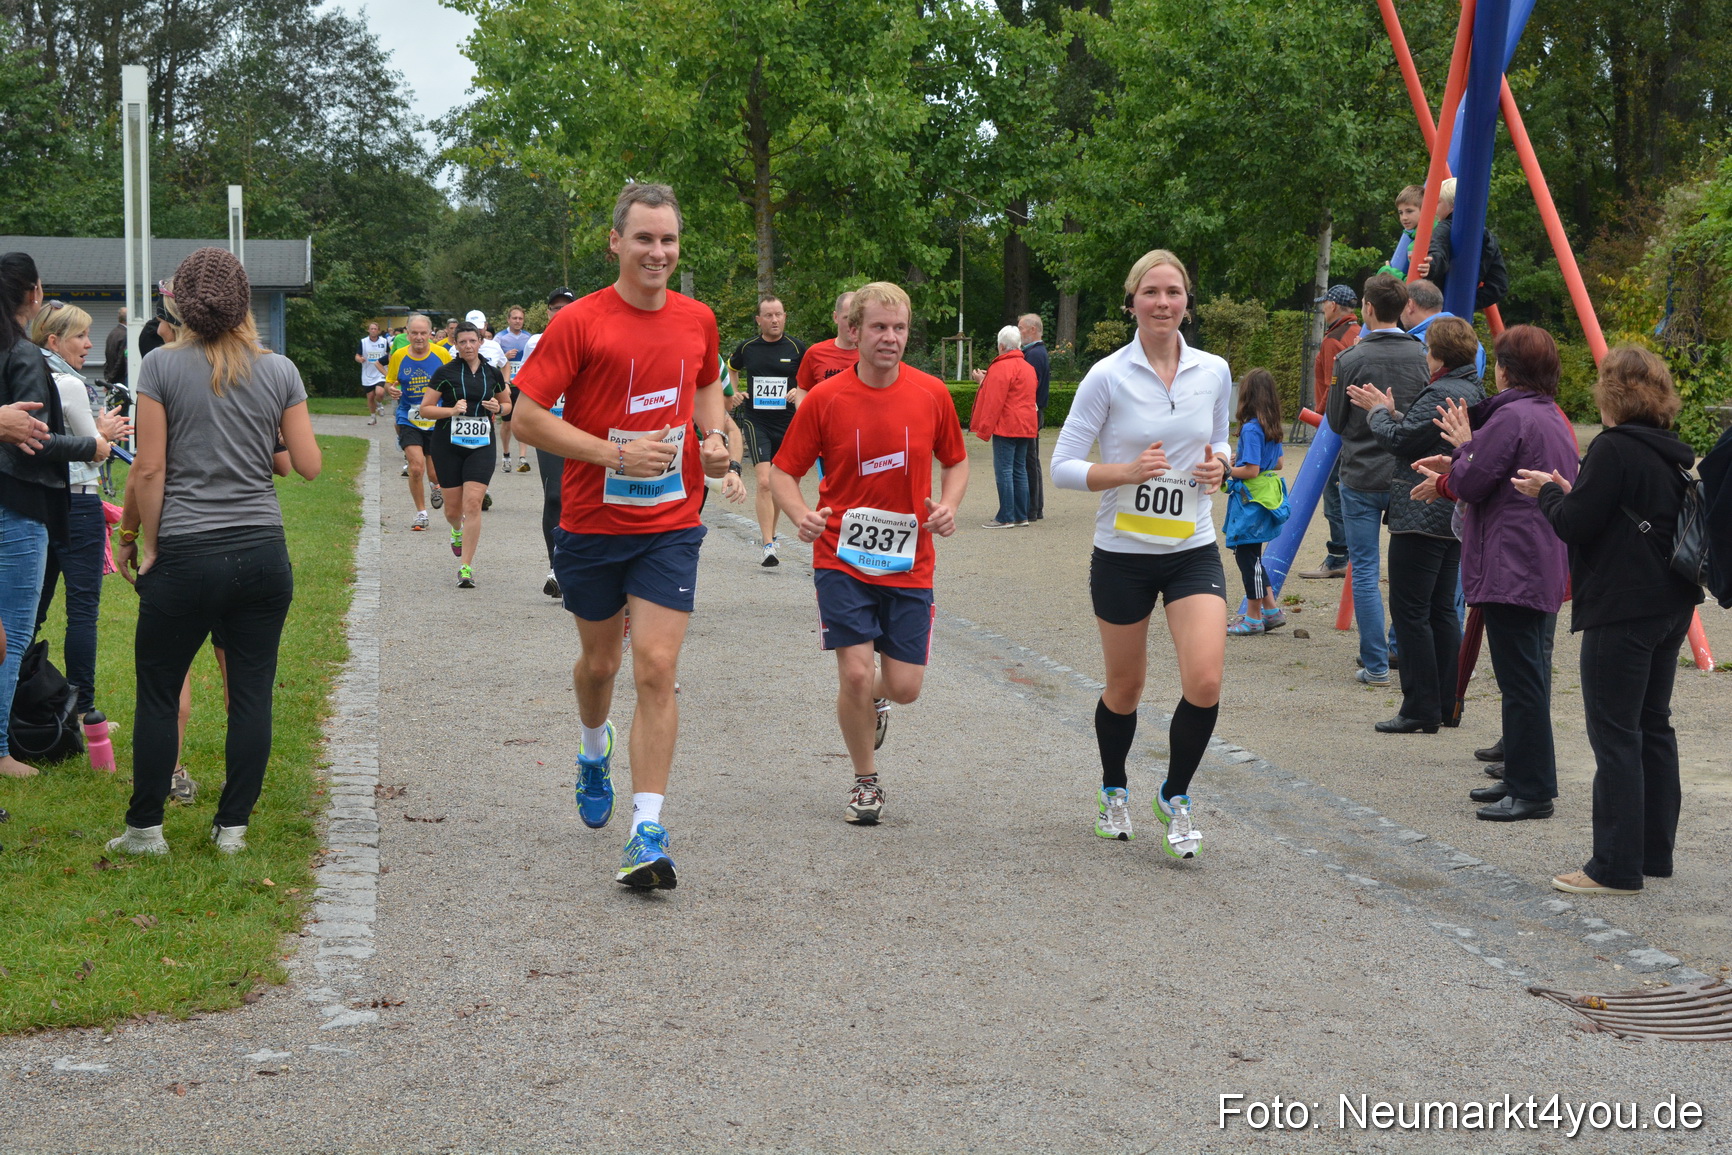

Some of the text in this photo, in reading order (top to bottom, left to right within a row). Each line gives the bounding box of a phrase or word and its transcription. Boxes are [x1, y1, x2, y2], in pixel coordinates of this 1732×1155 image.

[757, 385, 784, 396] 2447
[643, 395, 666, 406] DEHN
[456, 422, 486, 435] 2380
[874, 459, 892, 468] DEHN
[629, 484, 664, 497] Philipp
[1135, 484, 1183, 516] 600
[845, 512, 907, 527] PARTL Neumarkt
[847, 523, 911, 554] 2337
[858, 555, 891, 568] Reiner
